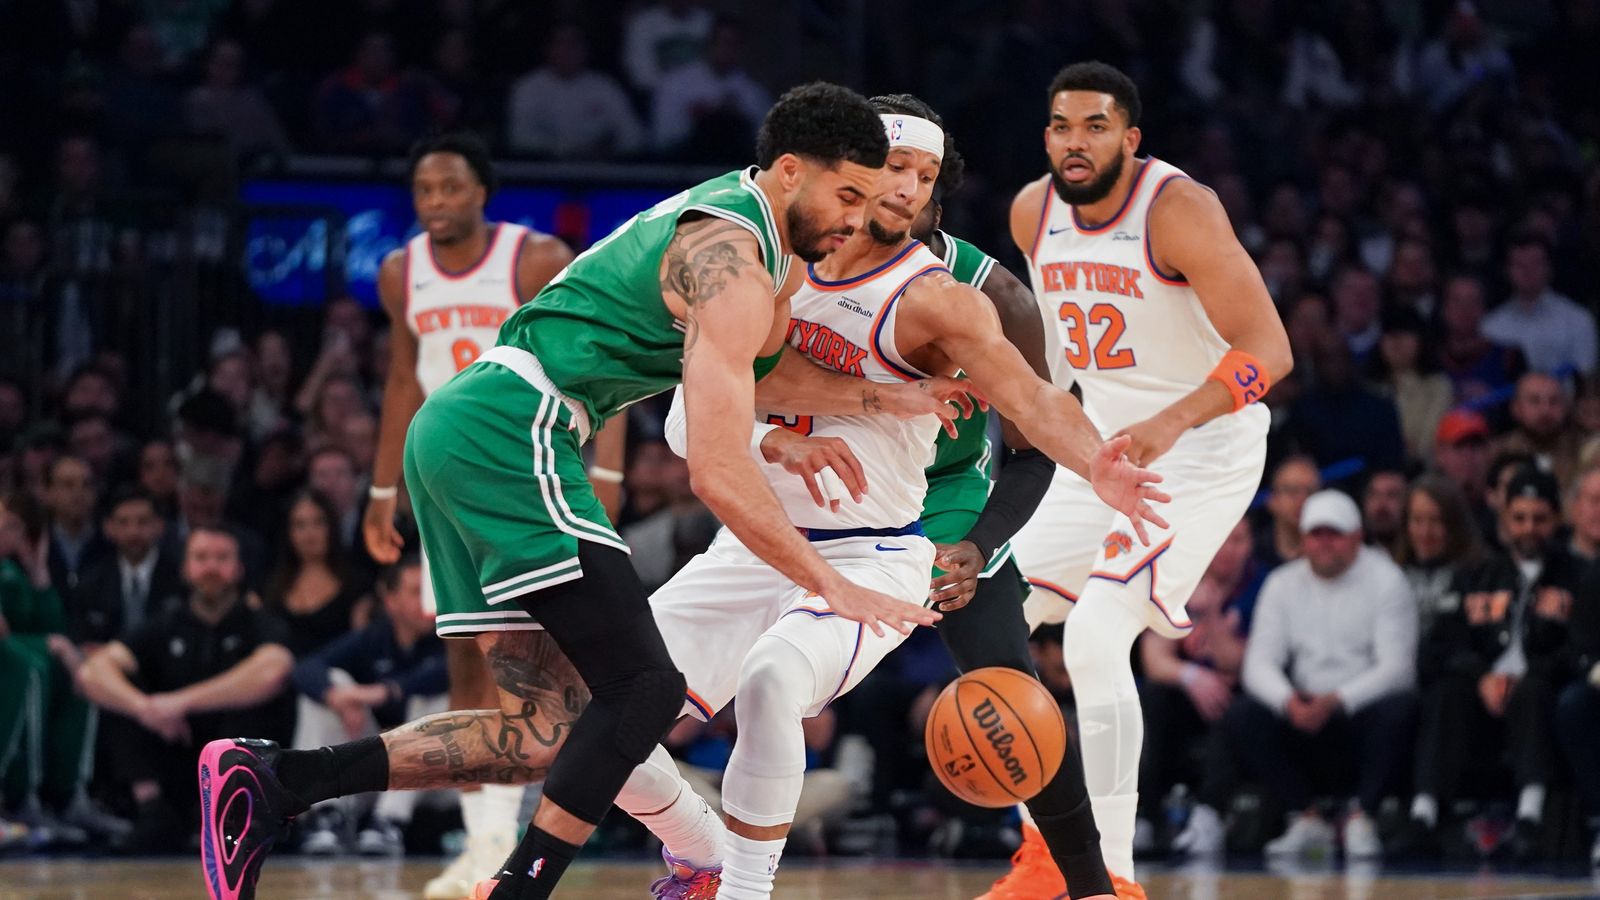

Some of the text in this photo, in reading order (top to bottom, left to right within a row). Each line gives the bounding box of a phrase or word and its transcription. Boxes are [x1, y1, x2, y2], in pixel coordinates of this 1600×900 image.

[837, 300, 852, 311] abu
[852, 305, 875, 319] dhabi
[1041, 262, 1144, 299] NEW YORK
[798, 319, 868, 379] YORK
[1059, 302, 1136, 370] 32
[972, 697, 1028, 786] Wilson
